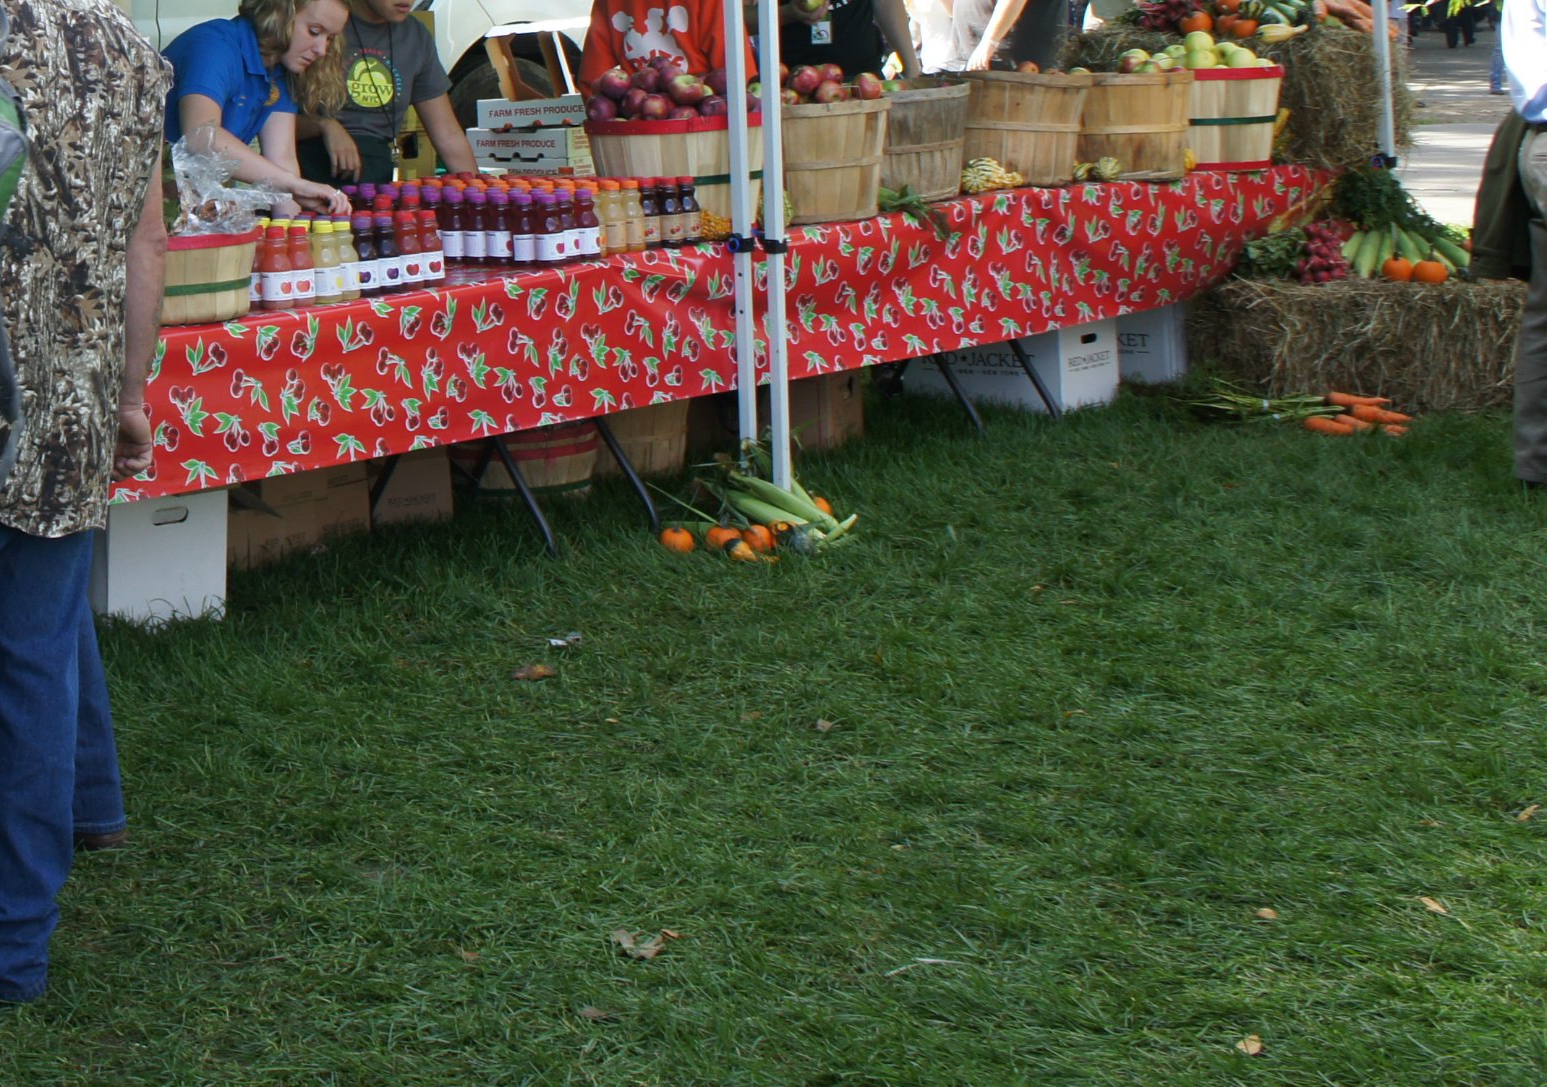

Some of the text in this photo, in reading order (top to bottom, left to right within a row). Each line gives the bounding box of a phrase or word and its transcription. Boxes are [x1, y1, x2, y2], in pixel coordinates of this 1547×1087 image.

[351, 82, 394, 99] grow
[489, 104, 584, 118] FARM FRESH PRODUCE
[476, 140, 556, 148] FARM FRESH PRODUCE
